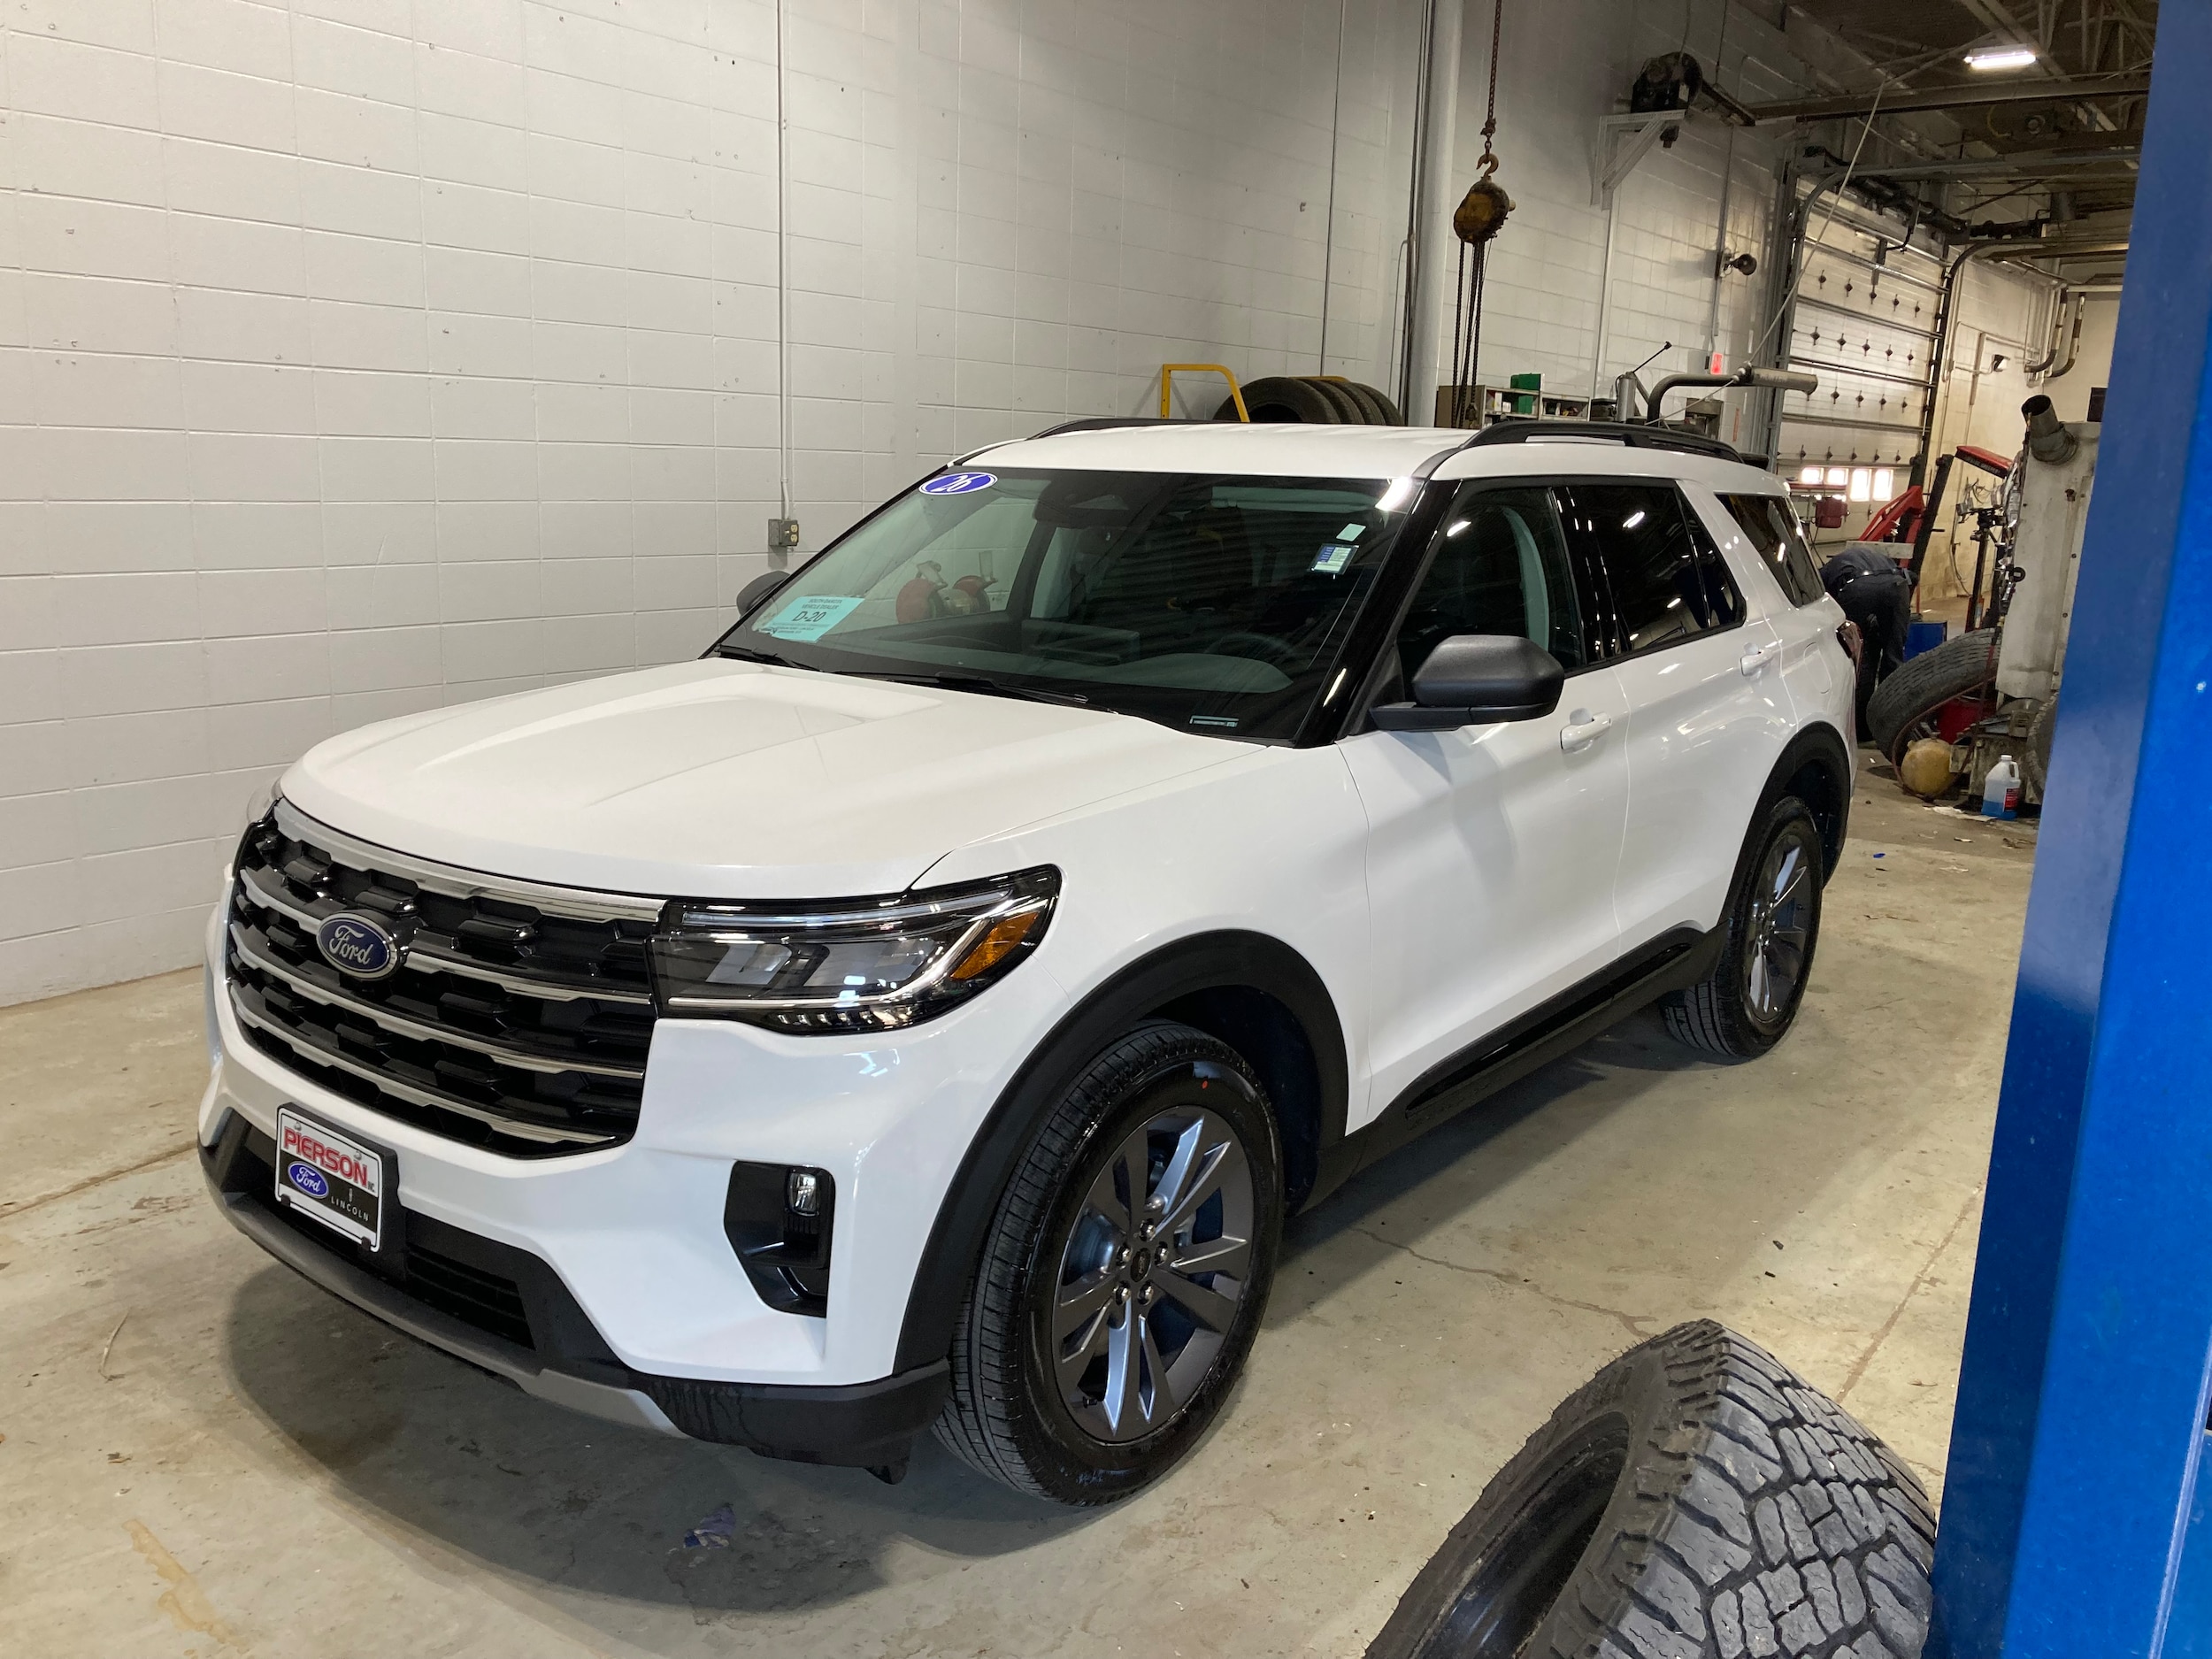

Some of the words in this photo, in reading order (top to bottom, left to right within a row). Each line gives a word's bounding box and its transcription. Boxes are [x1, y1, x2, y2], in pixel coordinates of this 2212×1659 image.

[930, 474, 984, 492] 26
[792, 611, 827, 622] D-20
[329, 925, 374, 965] Ford
[283, 1125, 368, 1187] PIERSON
[296, 1166, 322, 1194] Ford
[330, 1195, 370, 1223] LINCOLN
